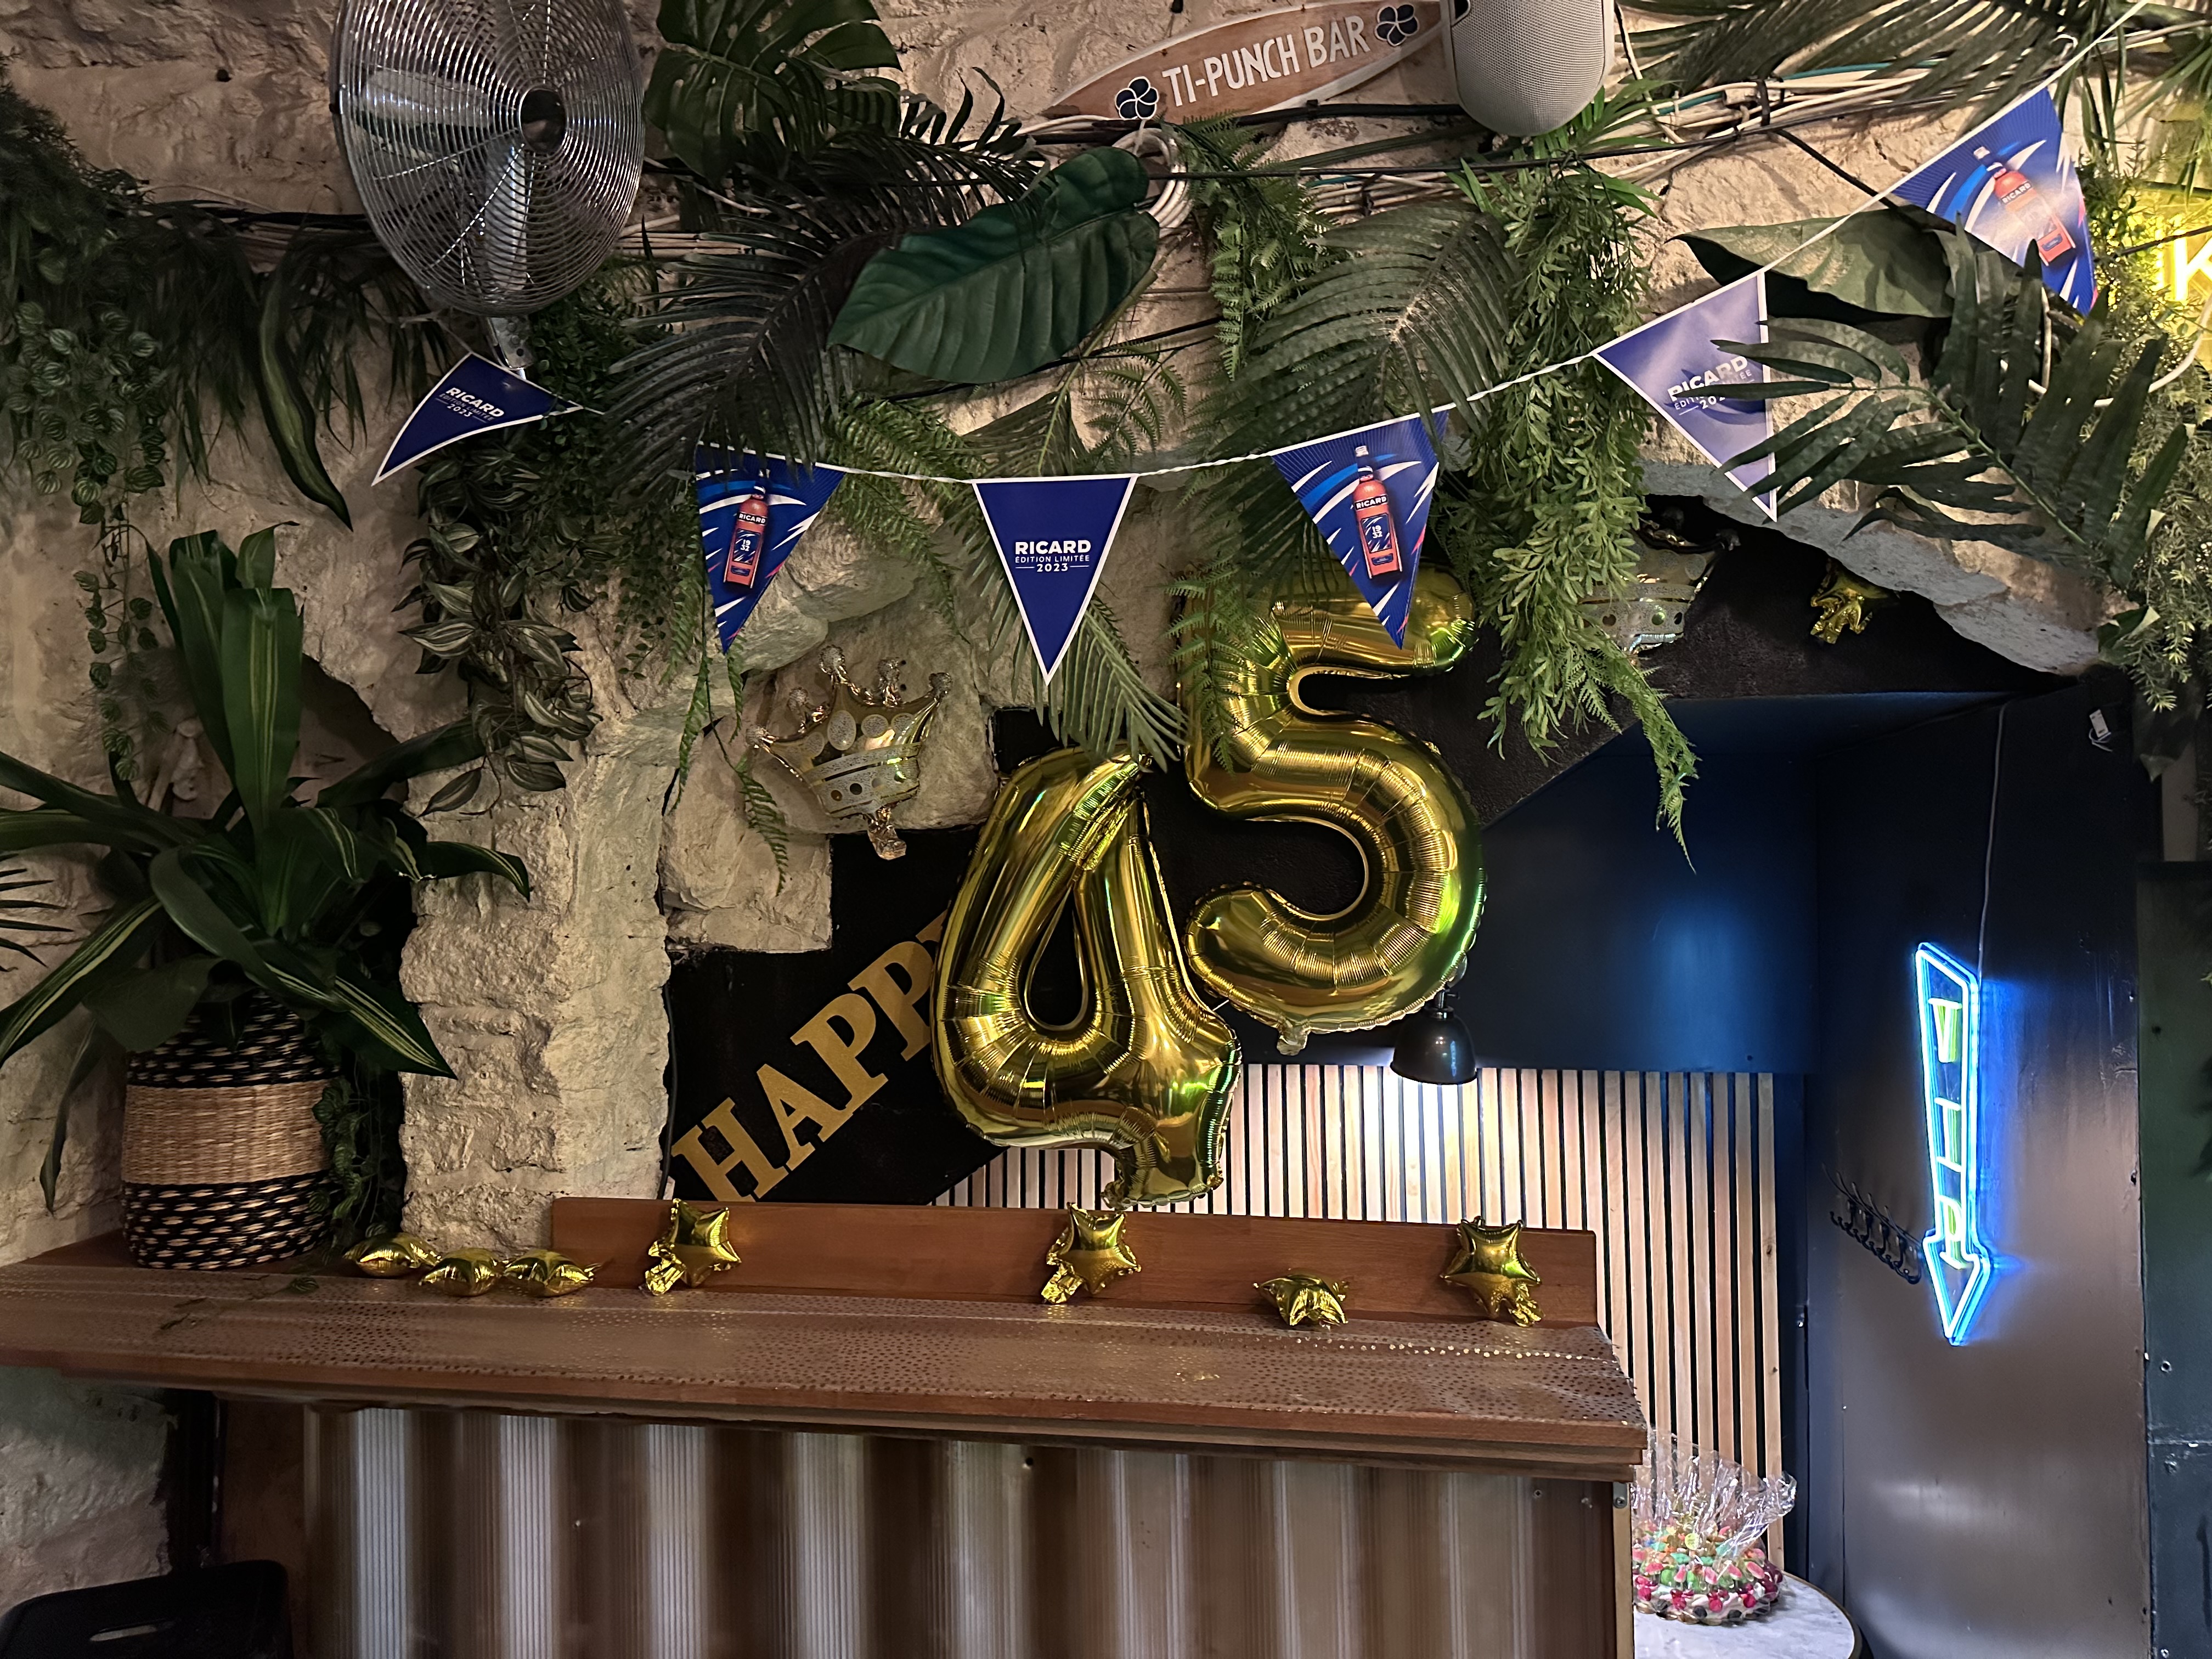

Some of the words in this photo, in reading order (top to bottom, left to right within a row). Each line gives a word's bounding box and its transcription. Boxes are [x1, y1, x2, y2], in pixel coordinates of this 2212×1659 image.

[1161, 33, 1300, 107] TI-PUNCH
[1303, 15, 1371, 68] BAR
[2002, 182, 2032, 204] RICARD
[1668, 356, 1747, 402] RICARD
[445, 387, 504, 417] RICARD
[447, 403, 473, 417] 2023
[1356, 496, 1387, 509] RICARD
[738, 514, 766, 523] RICARD
[1015, 540, 1091, 555] RICARD
[1054, 554, 1090, 562] LIMITÉE
[1036, 563, 1068, 572] 2023
[671, 909, 947, 1203] HAPP
[1928, 997, 1965, 1269] VIP
